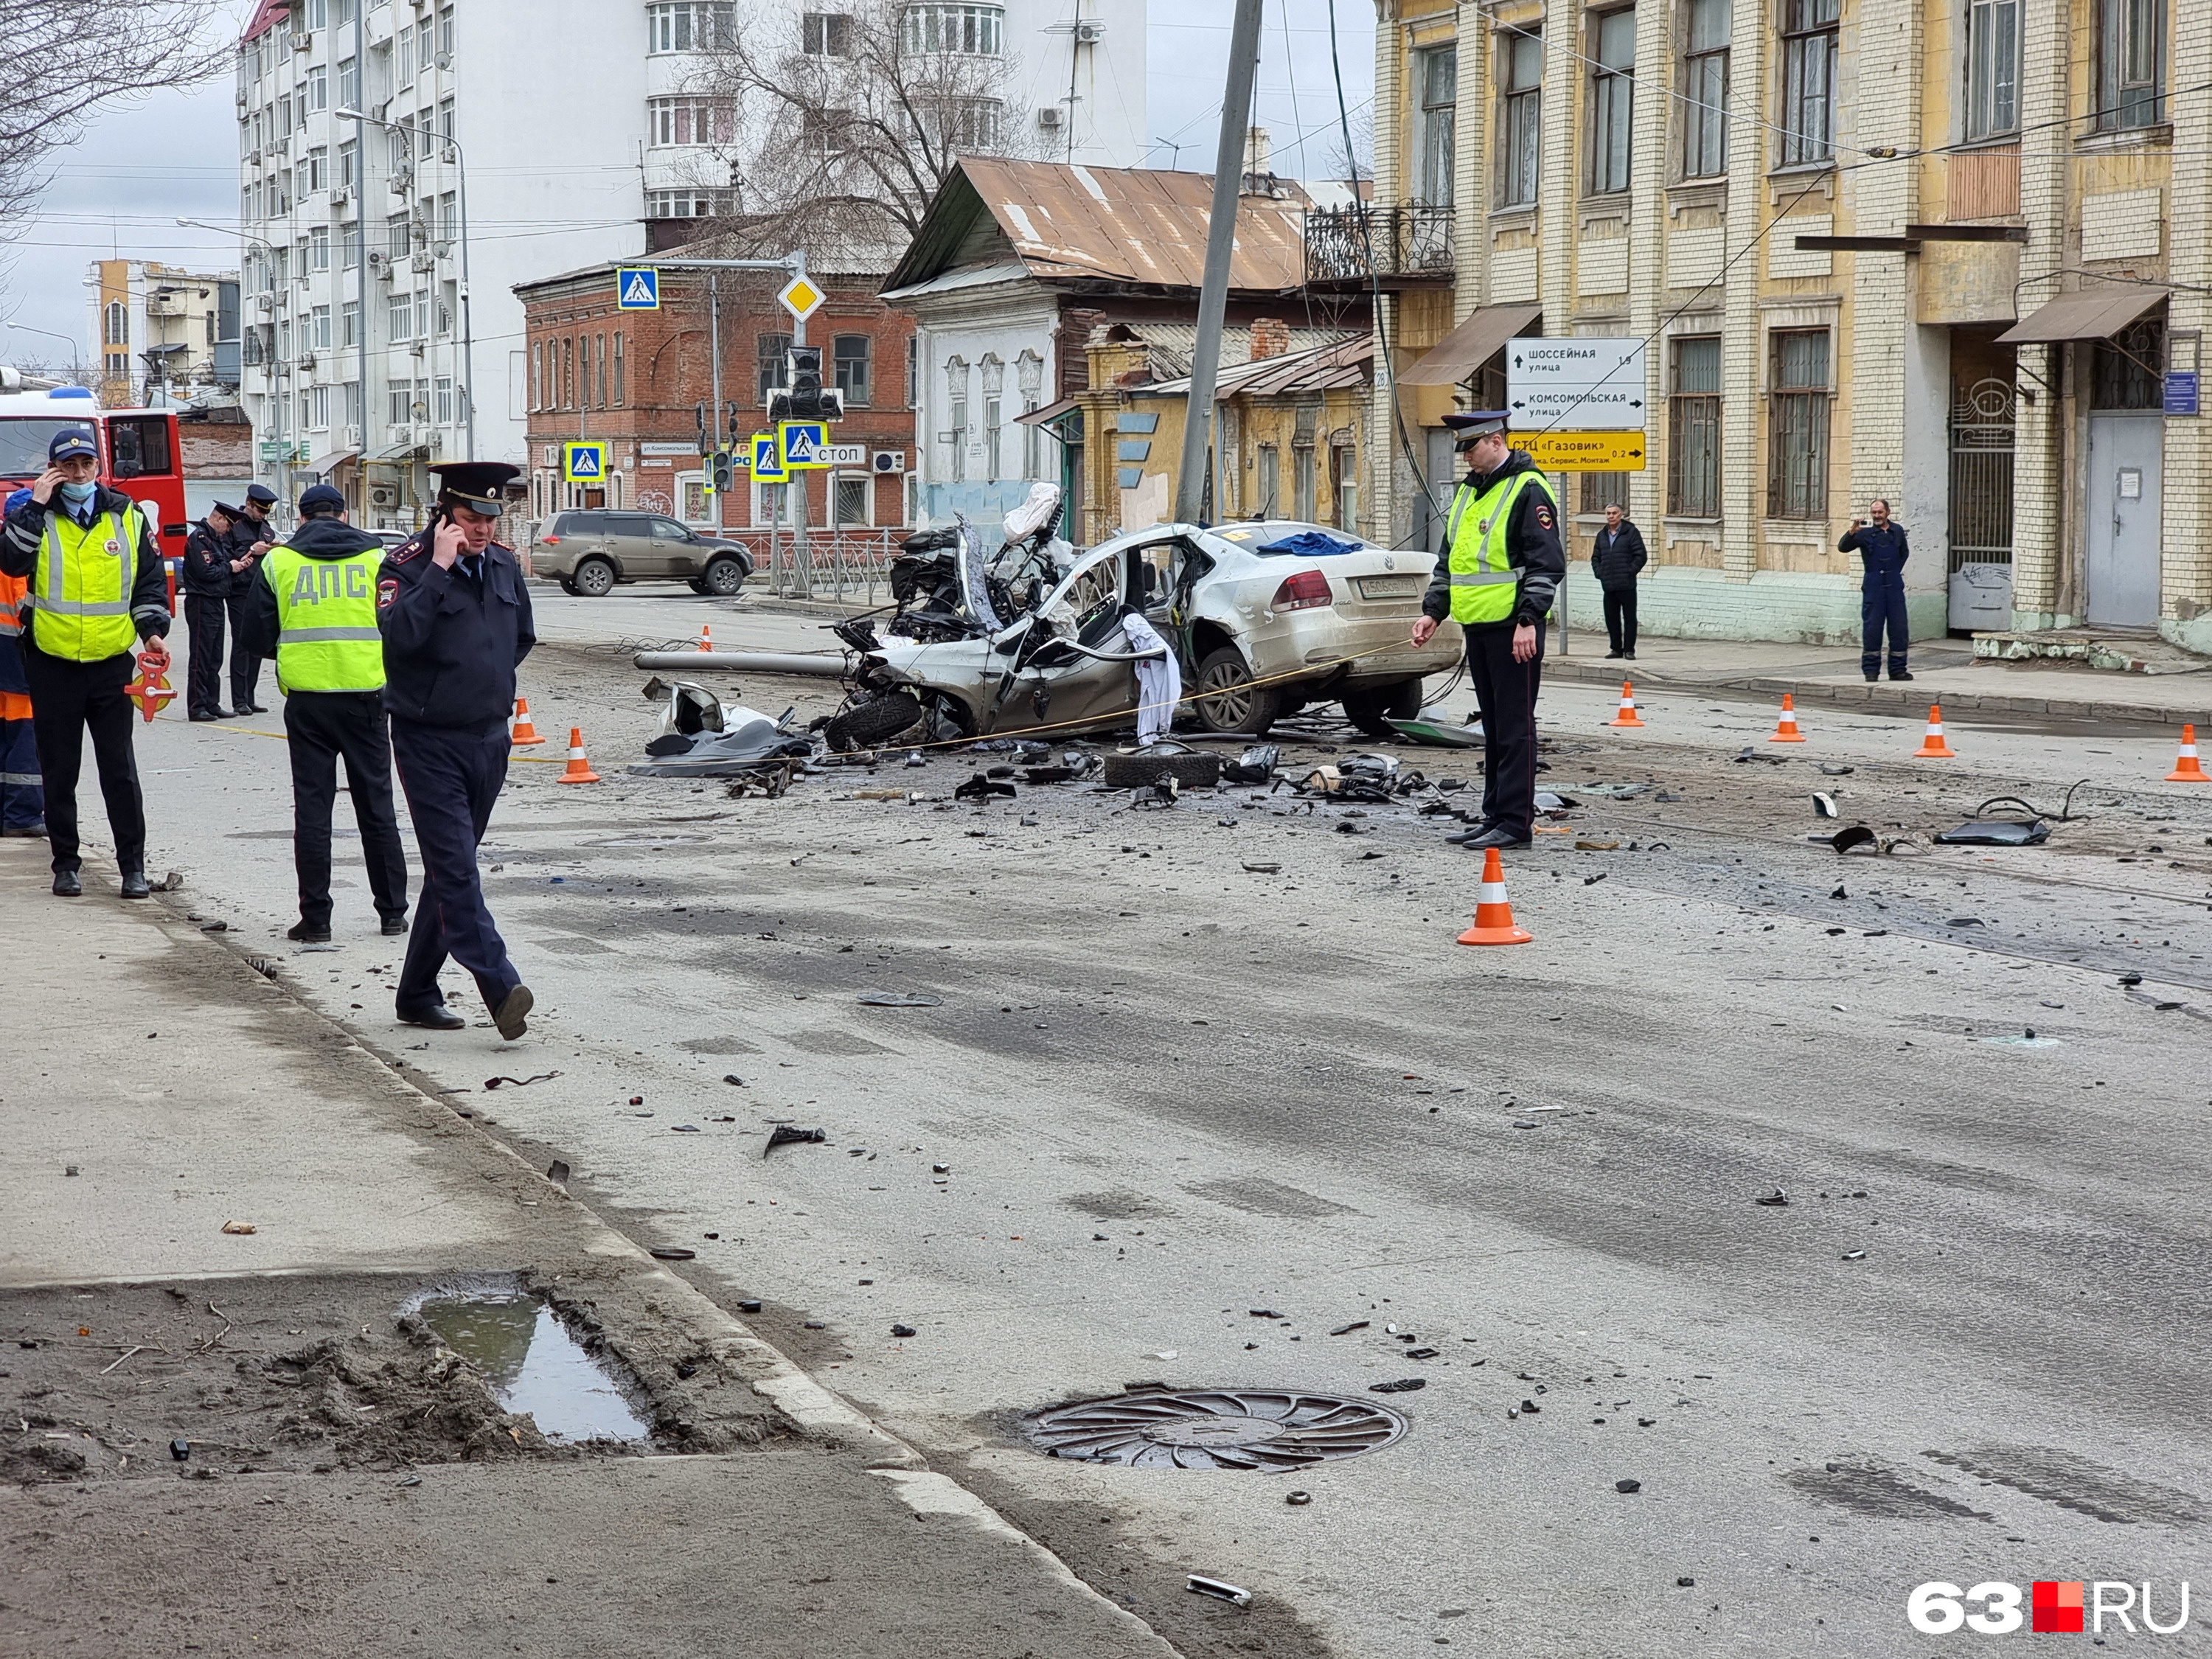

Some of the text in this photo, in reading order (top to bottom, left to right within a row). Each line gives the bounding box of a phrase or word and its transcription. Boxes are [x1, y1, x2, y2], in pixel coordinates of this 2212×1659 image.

[1528, 348, 1596, 359] ШОССЕЙНАЯ
[1528, 364, 1560, 373] улица
[1377, 372, 1385, 387] 28
[1529, 393, 1627, 403] КОМСОМОЛЬСКАЯ
[1529, 408, 1561, 418] улица
[1513, 440, 1604, 453] СТЦ «Газовик»
[818, 449, 858, 461] СТОП
[1612, 450, 1626, 459] 0.2
[291, 564, 366, 607] ДПС
